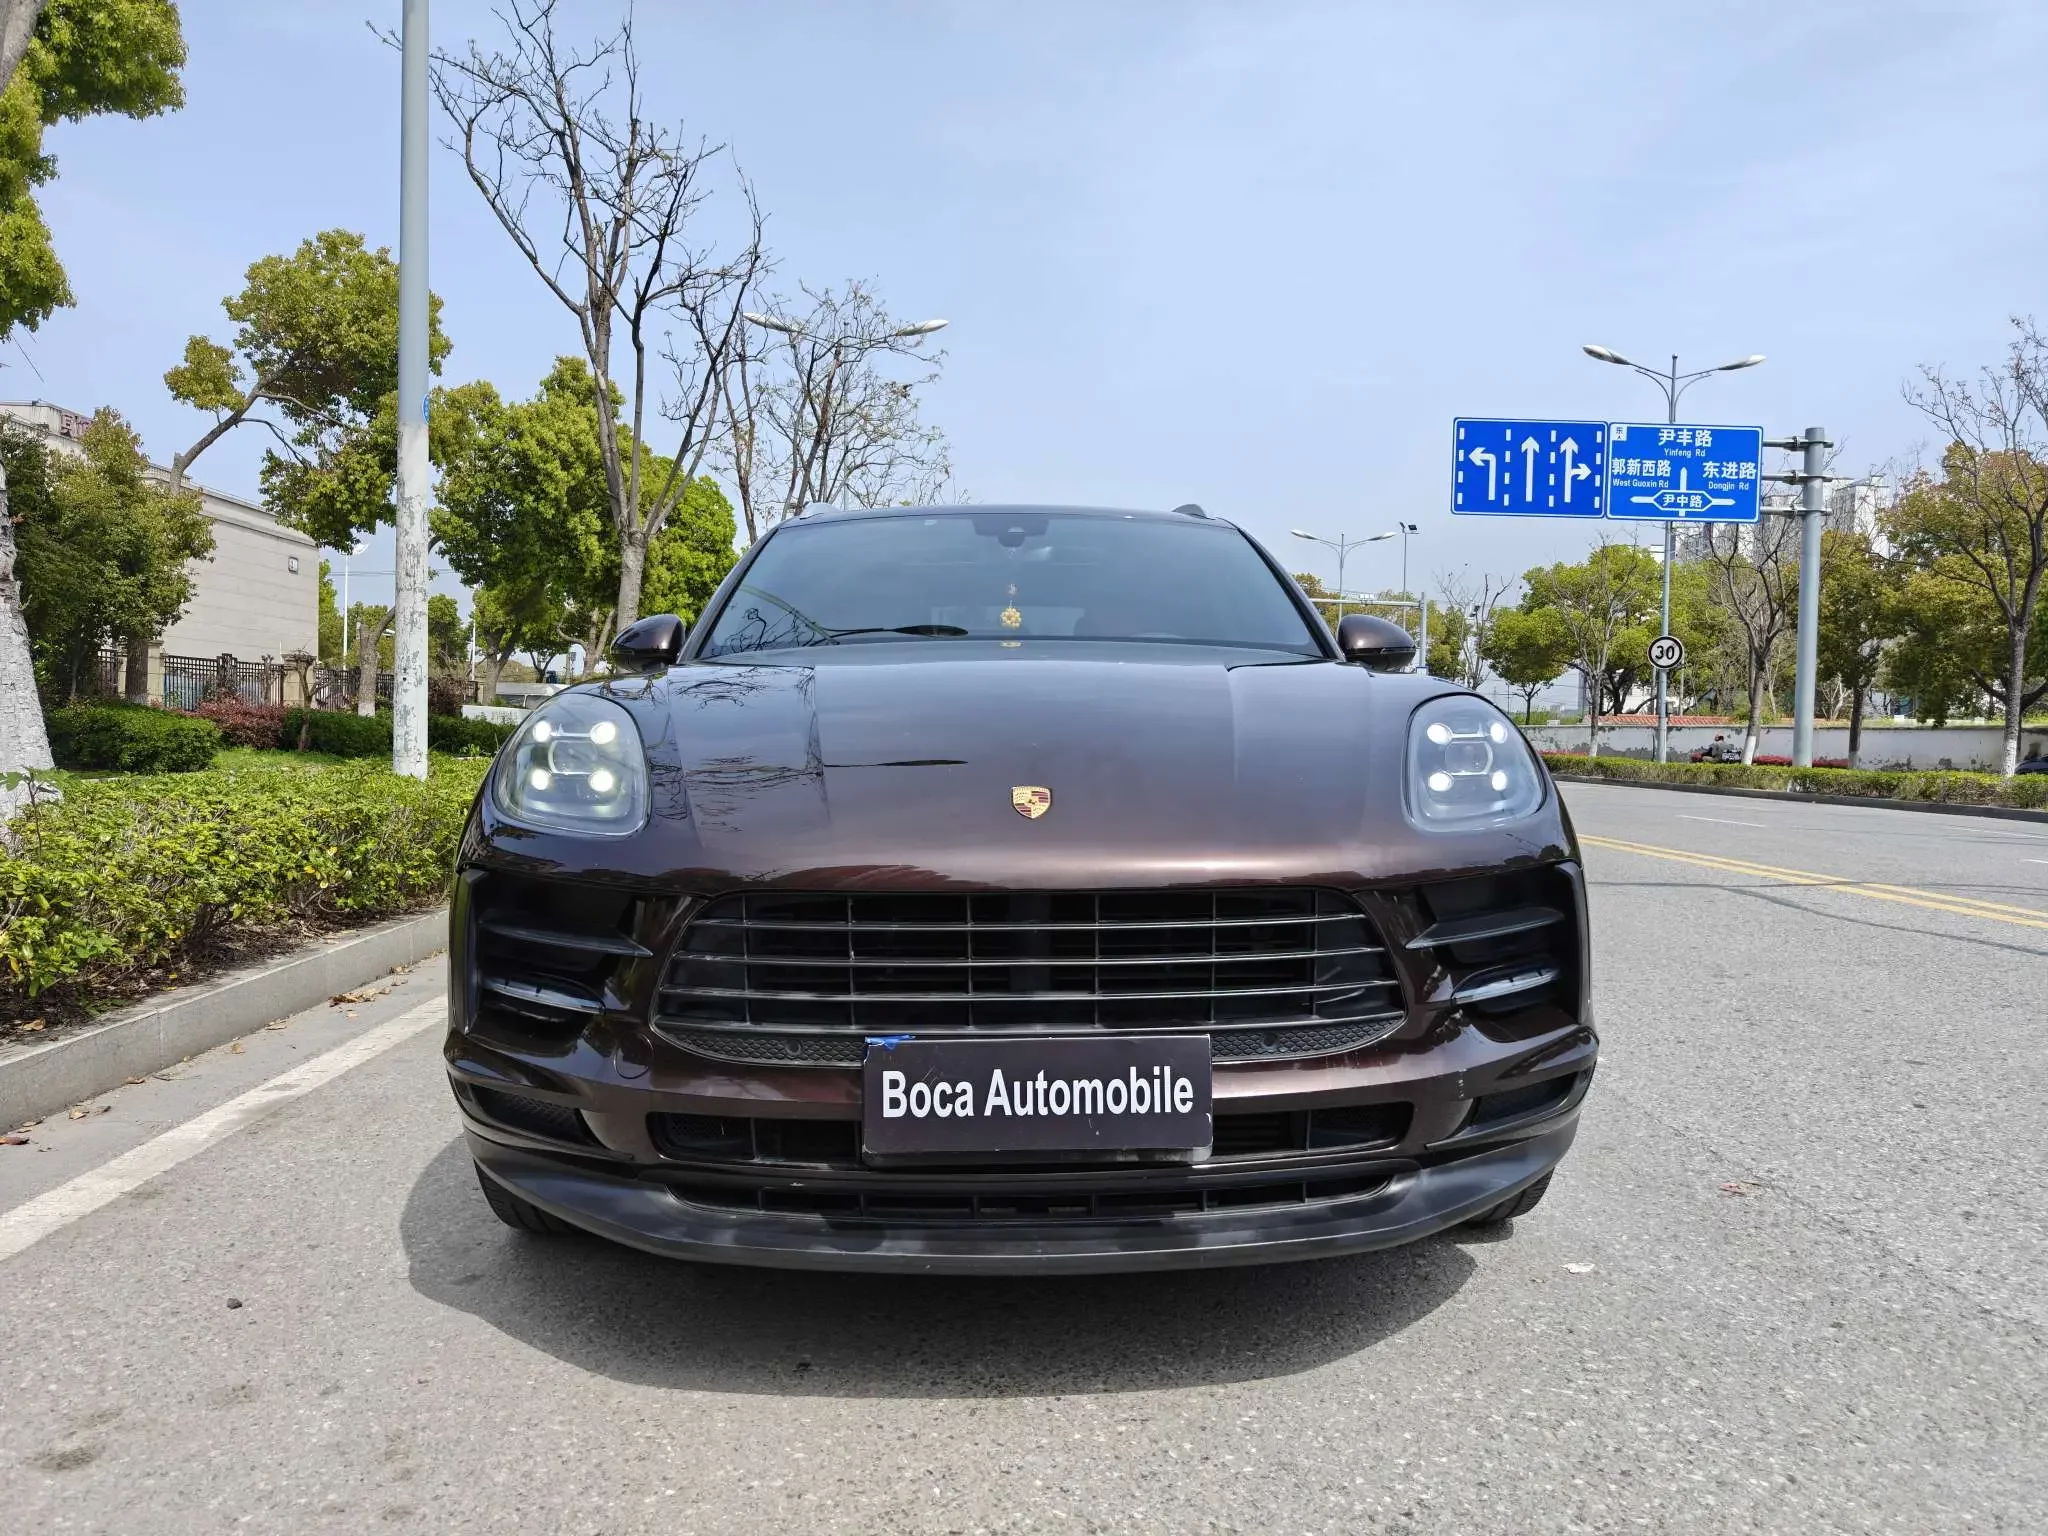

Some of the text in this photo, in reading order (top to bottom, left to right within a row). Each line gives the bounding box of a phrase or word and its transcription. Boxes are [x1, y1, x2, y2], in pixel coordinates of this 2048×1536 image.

[1658, 429, 1712, 447] 尹丰路
[1664, 448, 1706, 458] Yinfeng Rd
[1611, 458, 1671, 477] 郭新西路
[1702, 461, 1757, 479] 东进路
[1612, 478, 1669, 488] West Guoxin Rd
[1708, 481, 1749, 491] Dongjin Rd
[1662, 494, 1703, 508] 尹中路
[1655, 645, 1675, 660] 30
[881, 1065, 1194, 1119] Boca Automobile
